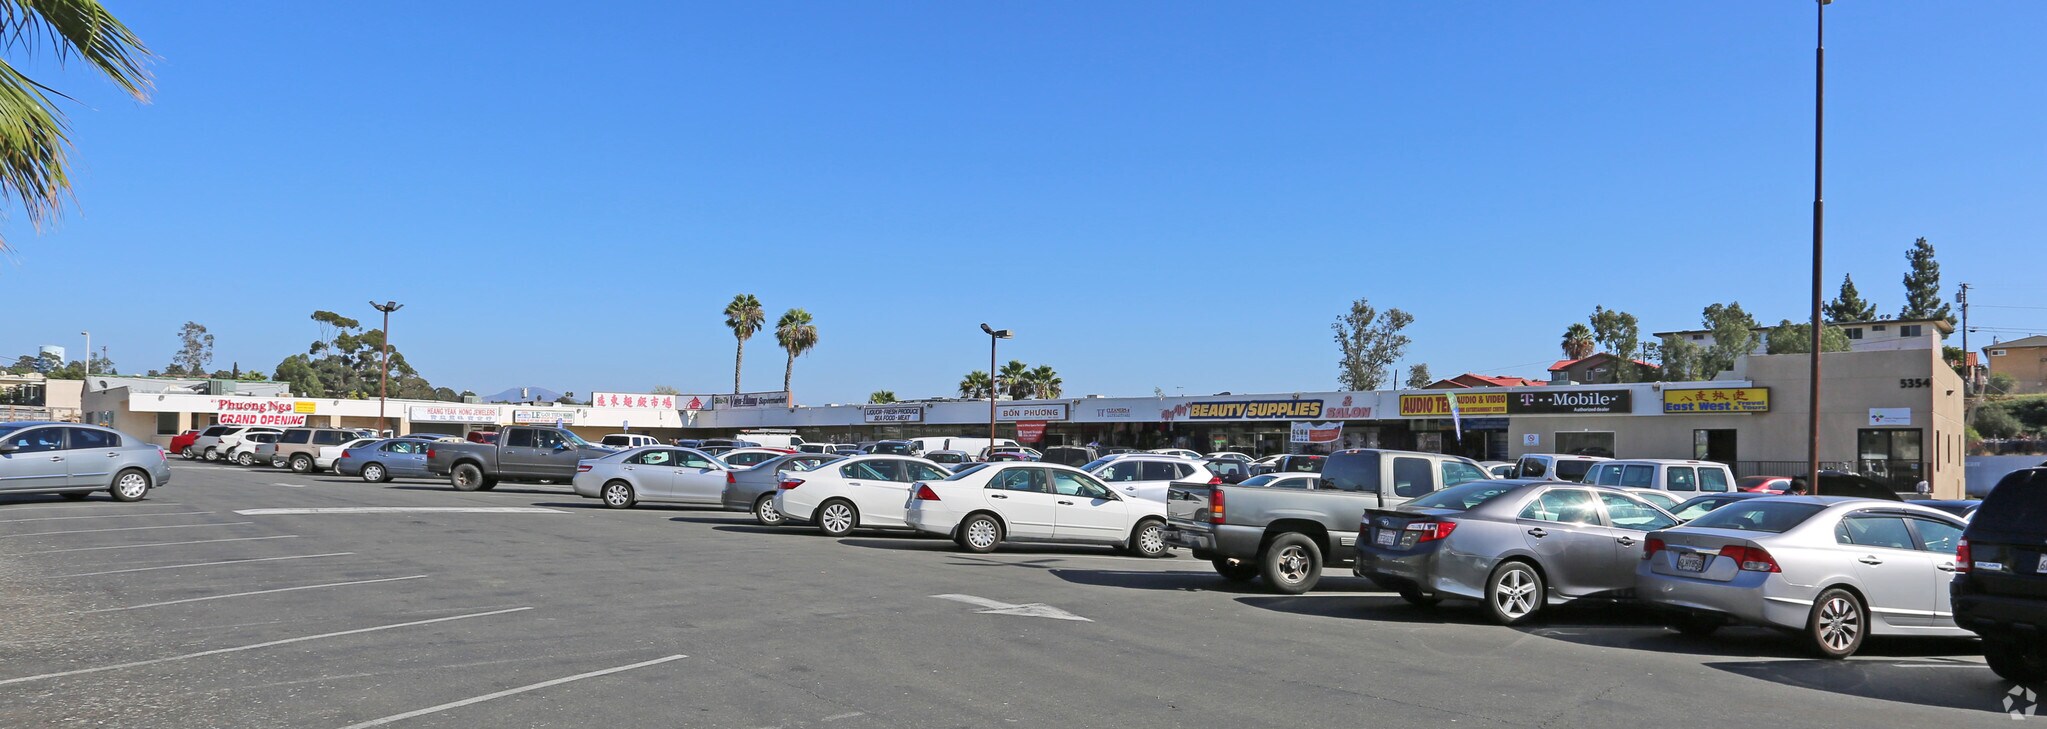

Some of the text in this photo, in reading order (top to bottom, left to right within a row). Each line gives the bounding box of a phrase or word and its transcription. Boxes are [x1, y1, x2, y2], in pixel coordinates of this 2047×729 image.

[1900, 378, 1931, 389] 5354
[1342, 395, 1353, 406] &
[1457, 394, 1506, 405] AUDIO & VIDEO
[268, 401, 292, 413] Nga
[1190, 402, 1321, 417] BEAUTY SUPPLIES
[1402, 397, 1434, 414] AUDIO
[1665, 402, 1695, 411] East
[1698, 402, 1731, 411] West
[1326, 407, 1371, 418] SALON
[220, 414, 305, 425] GRAND OPENING
